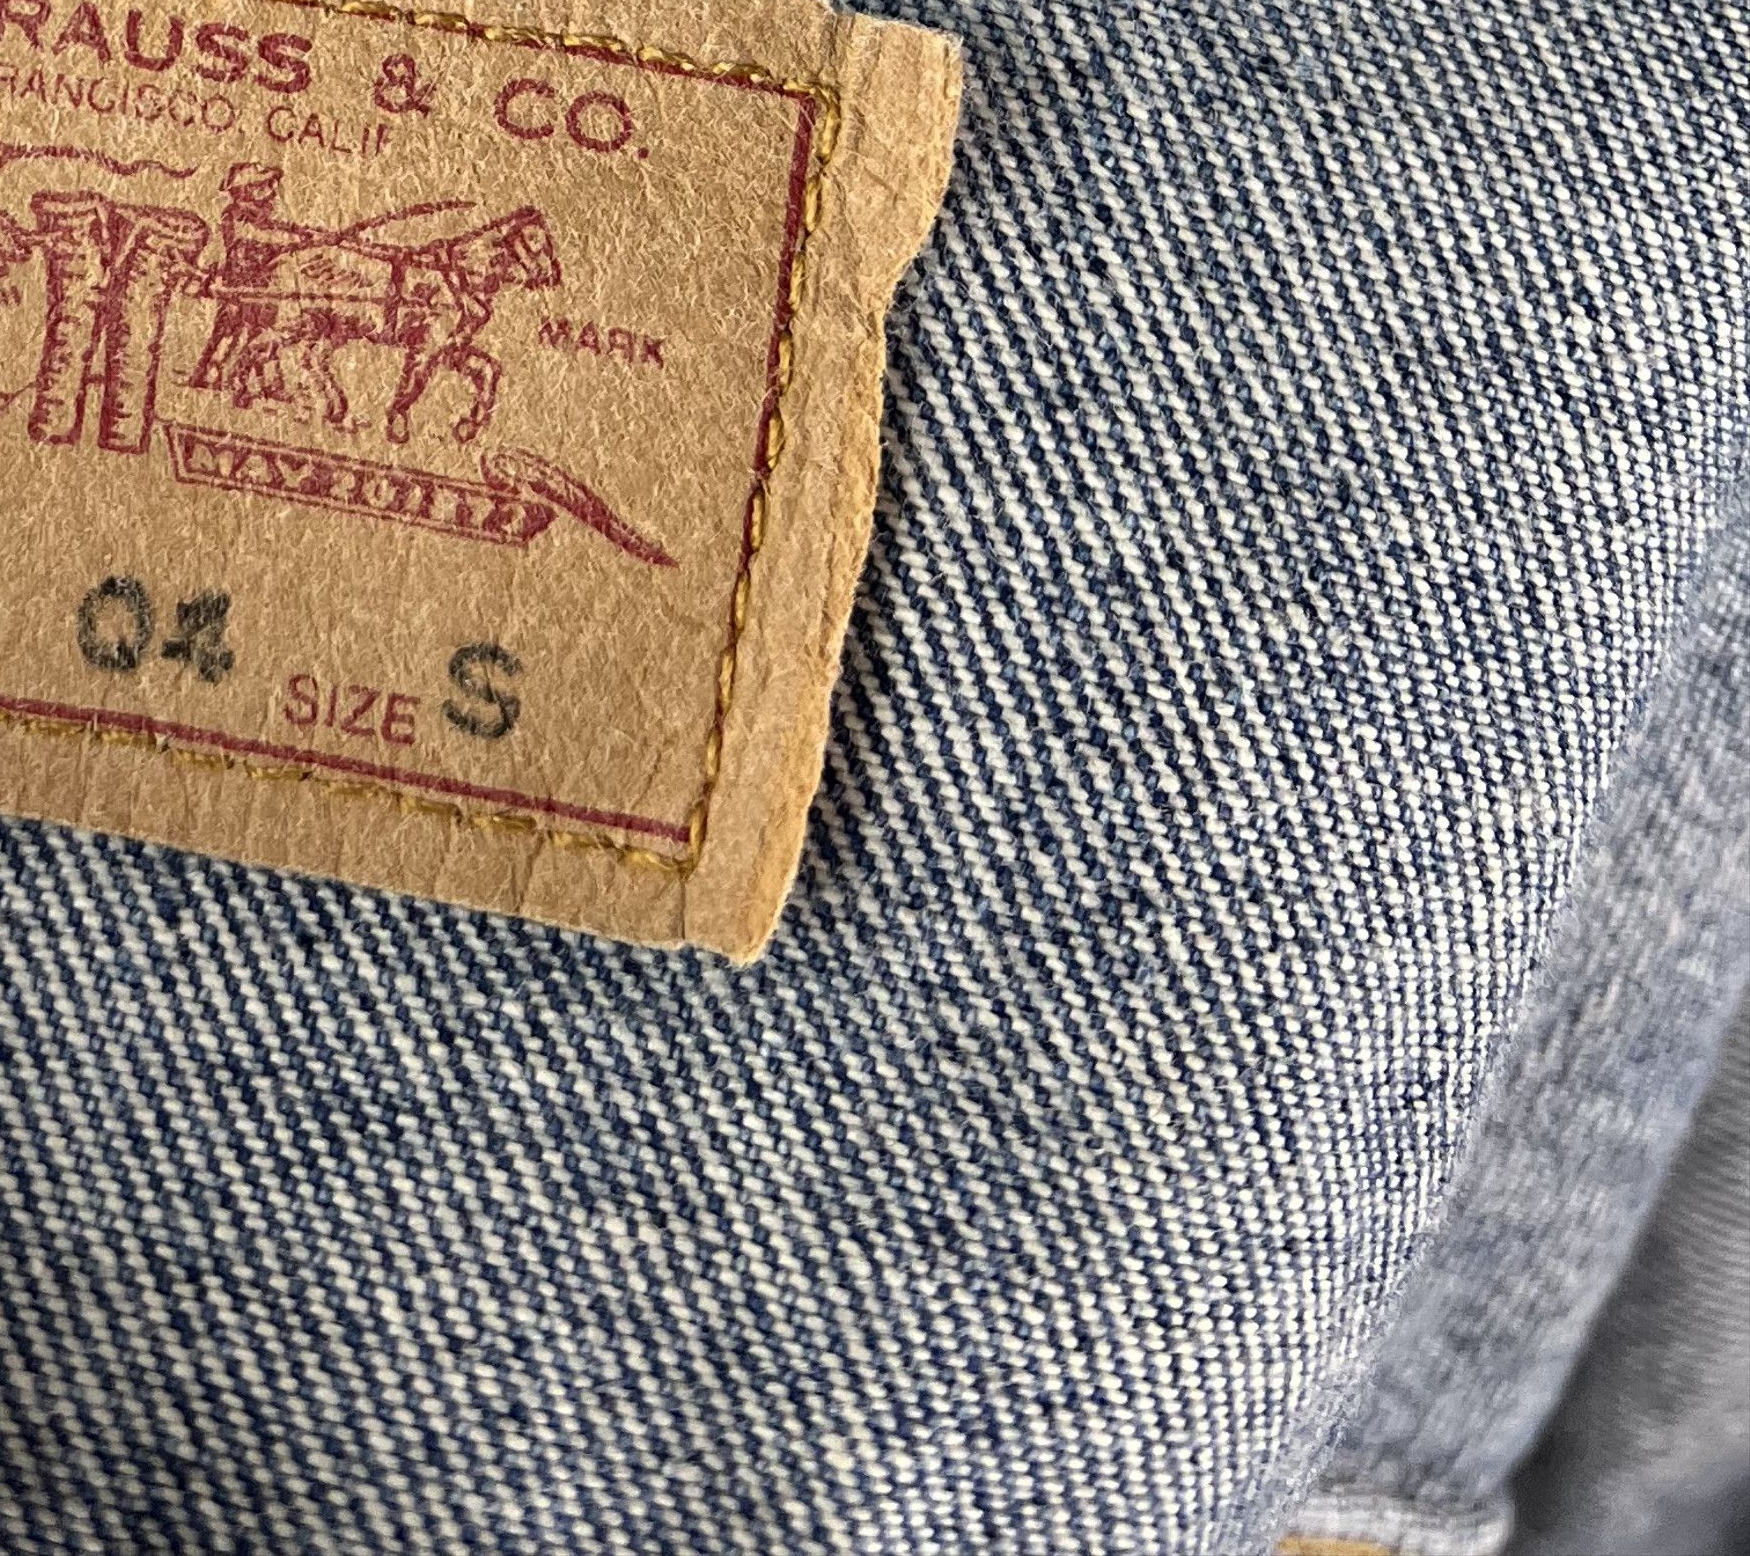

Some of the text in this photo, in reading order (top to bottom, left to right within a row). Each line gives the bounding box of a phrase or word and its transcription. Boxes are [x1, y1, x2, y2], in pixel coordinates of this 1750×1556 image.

[373, 53, 436, 118] &
[493, 78, 650, 160] CO.
[537, 316, 666, 370] MARK
[284, 642, 523, 746] SIZE S
